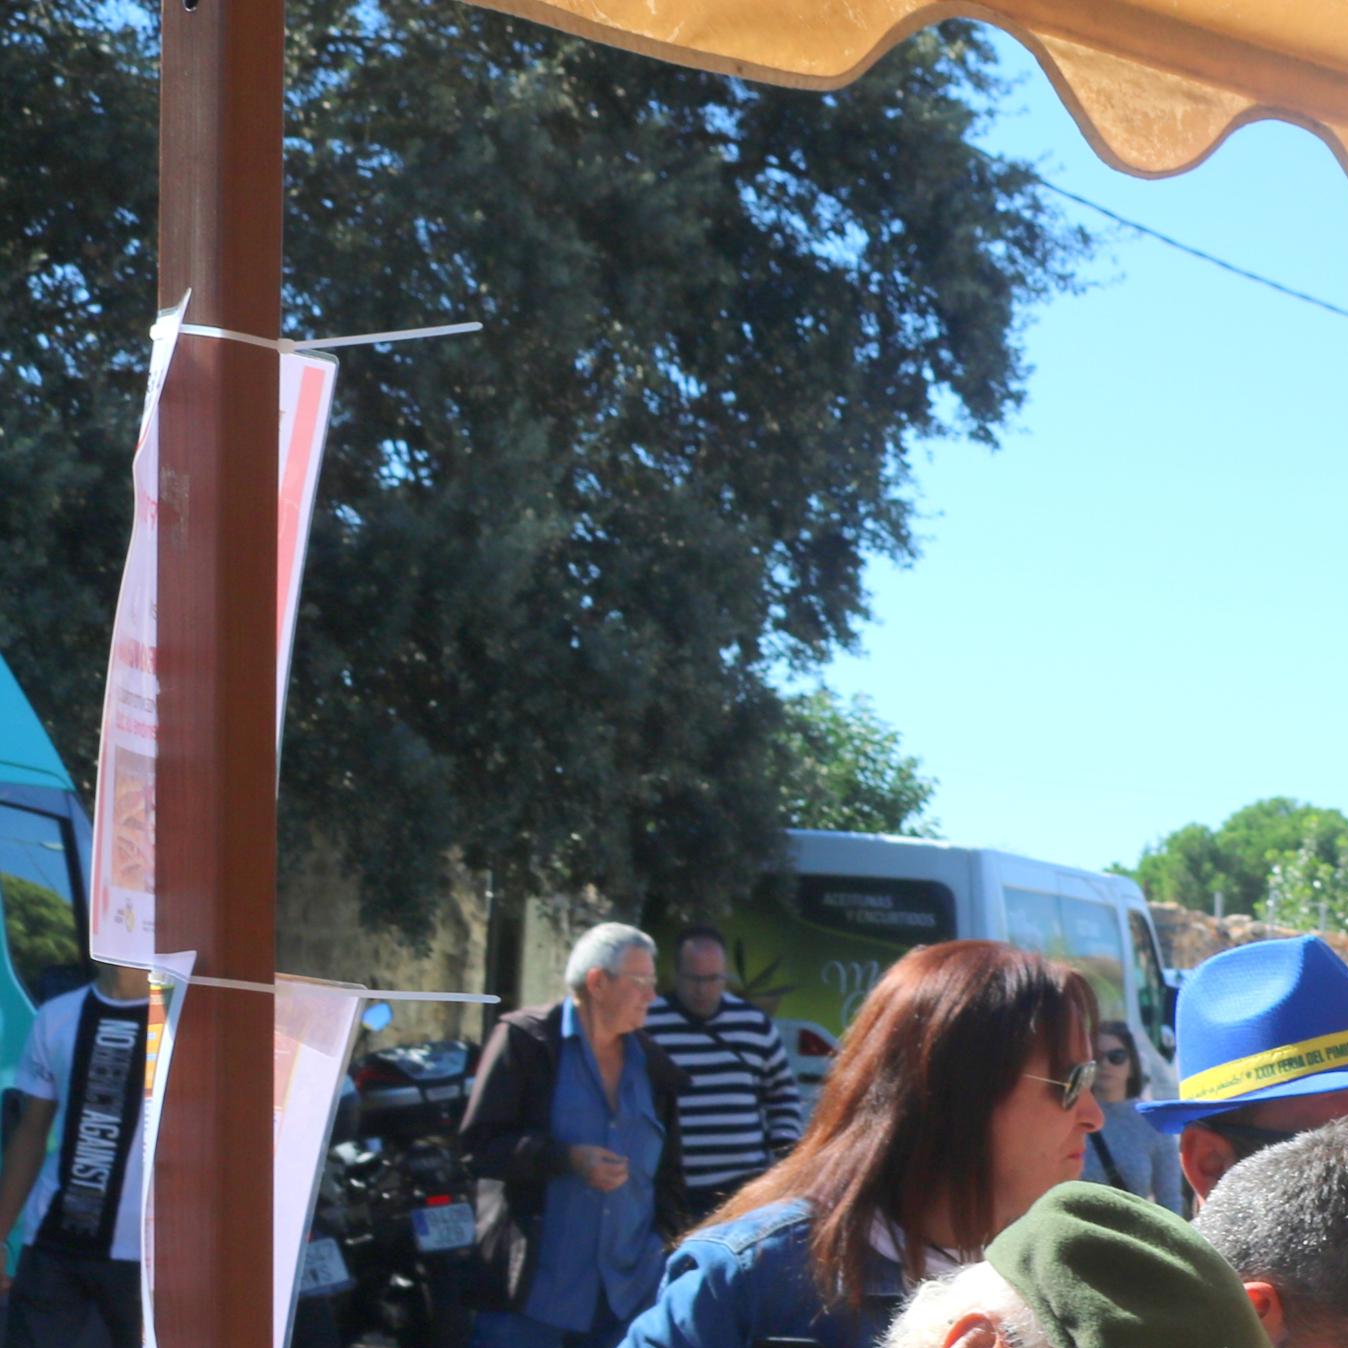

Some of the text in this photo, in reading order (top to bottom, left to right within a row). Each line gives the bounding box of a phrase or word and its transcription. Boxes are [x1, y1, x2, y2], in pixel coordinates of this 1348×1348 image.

[95, 1019, 140, 1049] NO
[1306, 1049, 1325, 1066] DEL
[70, 1108, 122, 1193] AGAINST
